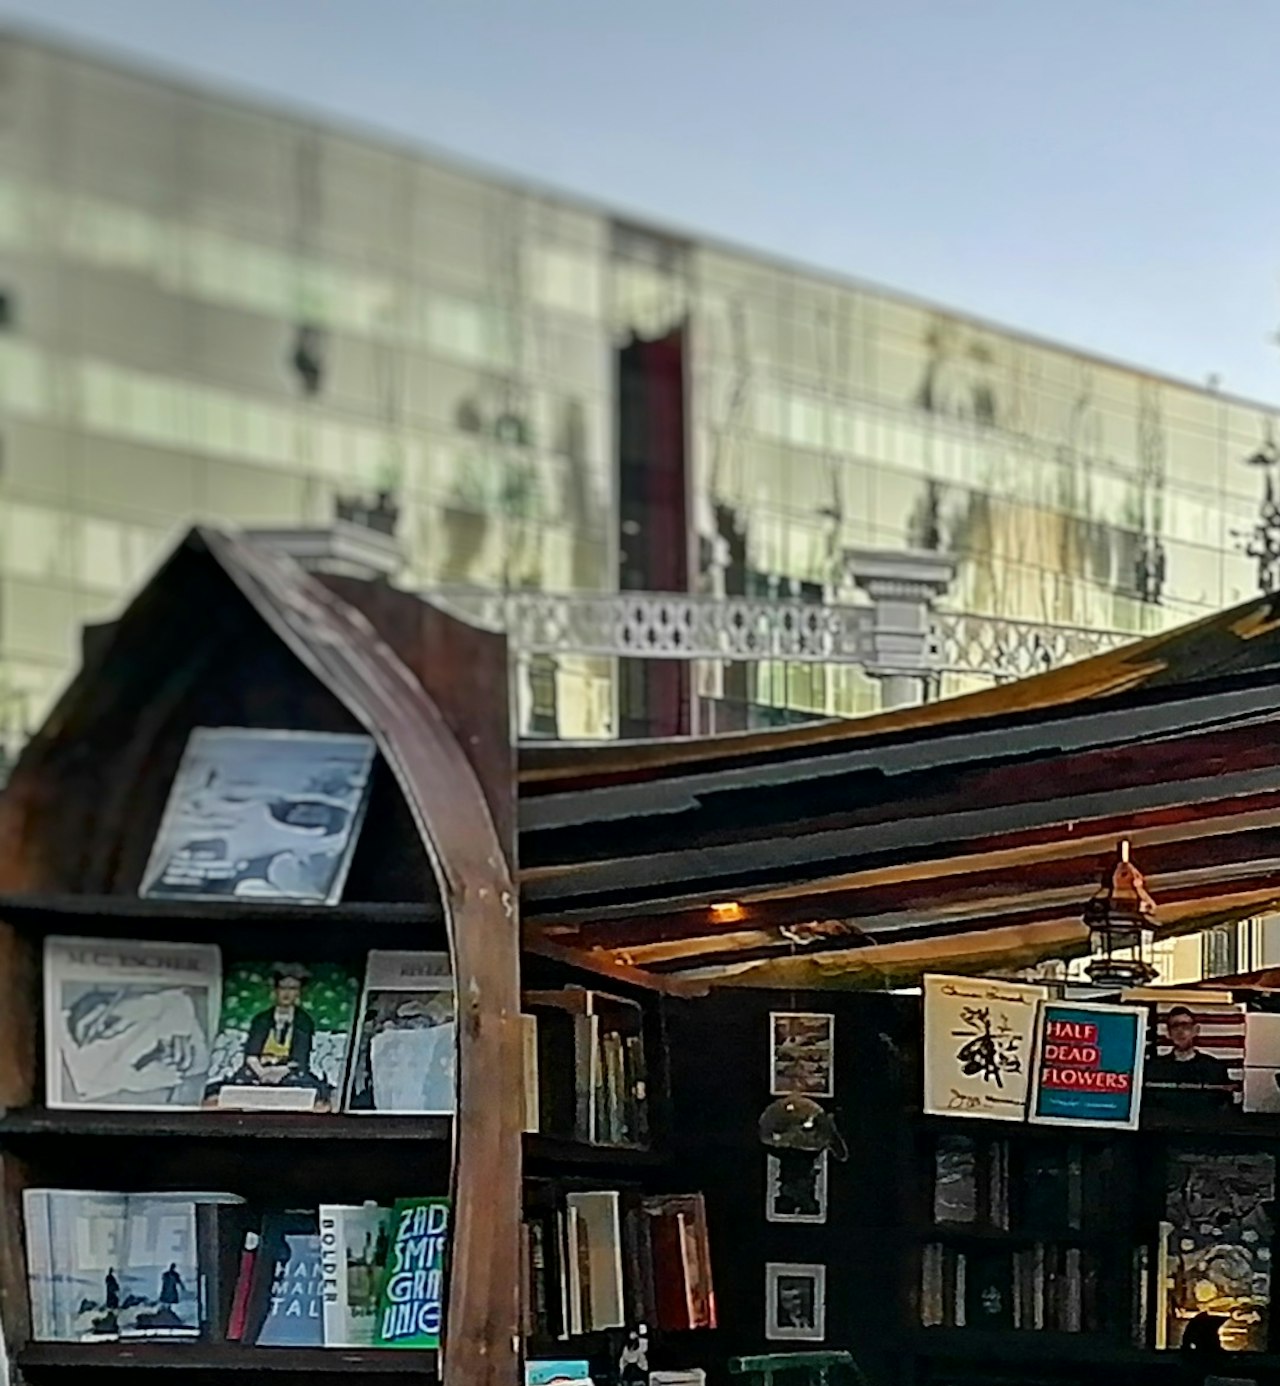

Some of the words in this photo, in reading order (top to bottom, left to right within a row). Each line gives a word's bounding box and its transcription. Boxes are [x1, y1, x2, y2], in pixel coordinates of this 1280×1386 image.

[1045, 1021, 1095, 1039] HALF
[1044, 1044, 1097, 1062] DEAD
[1042, 1068, 1129, 1089] FLOWERS
[322, 1218, 337, 1304] BOLDER
